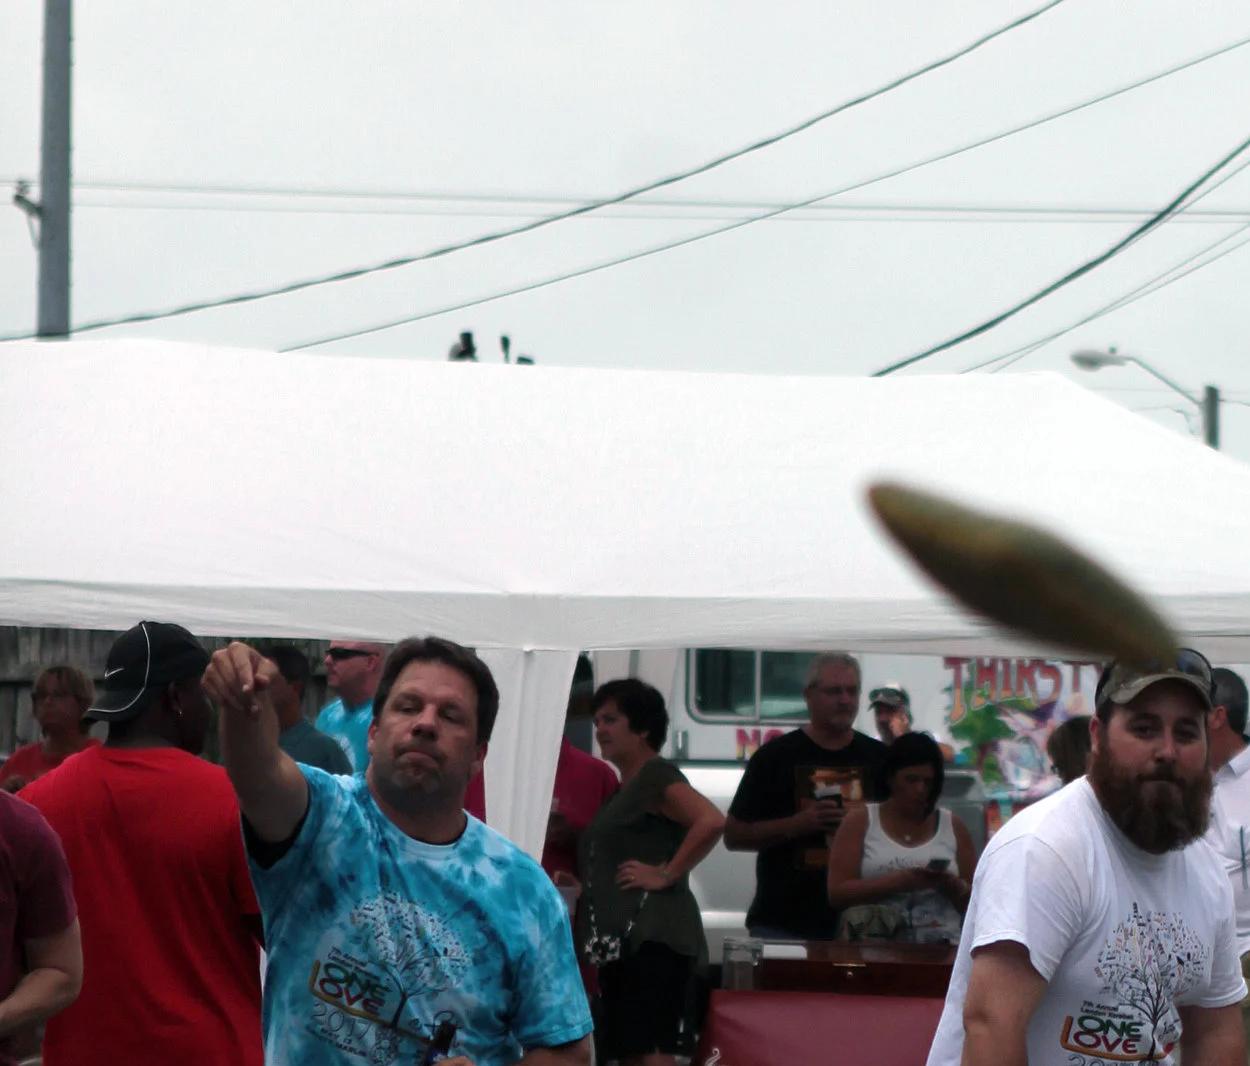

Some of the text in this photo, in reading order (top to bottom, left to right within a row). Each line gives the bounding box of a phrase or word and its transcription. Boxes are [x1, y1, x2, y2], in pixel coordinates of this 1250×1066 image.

[944, 657, 1103, 725] THIRST
[324, 962, 393, 999] ONE
[310, 1002, 373, 1041] 2017
[1077, 1015, 1145, 1039] ONE
